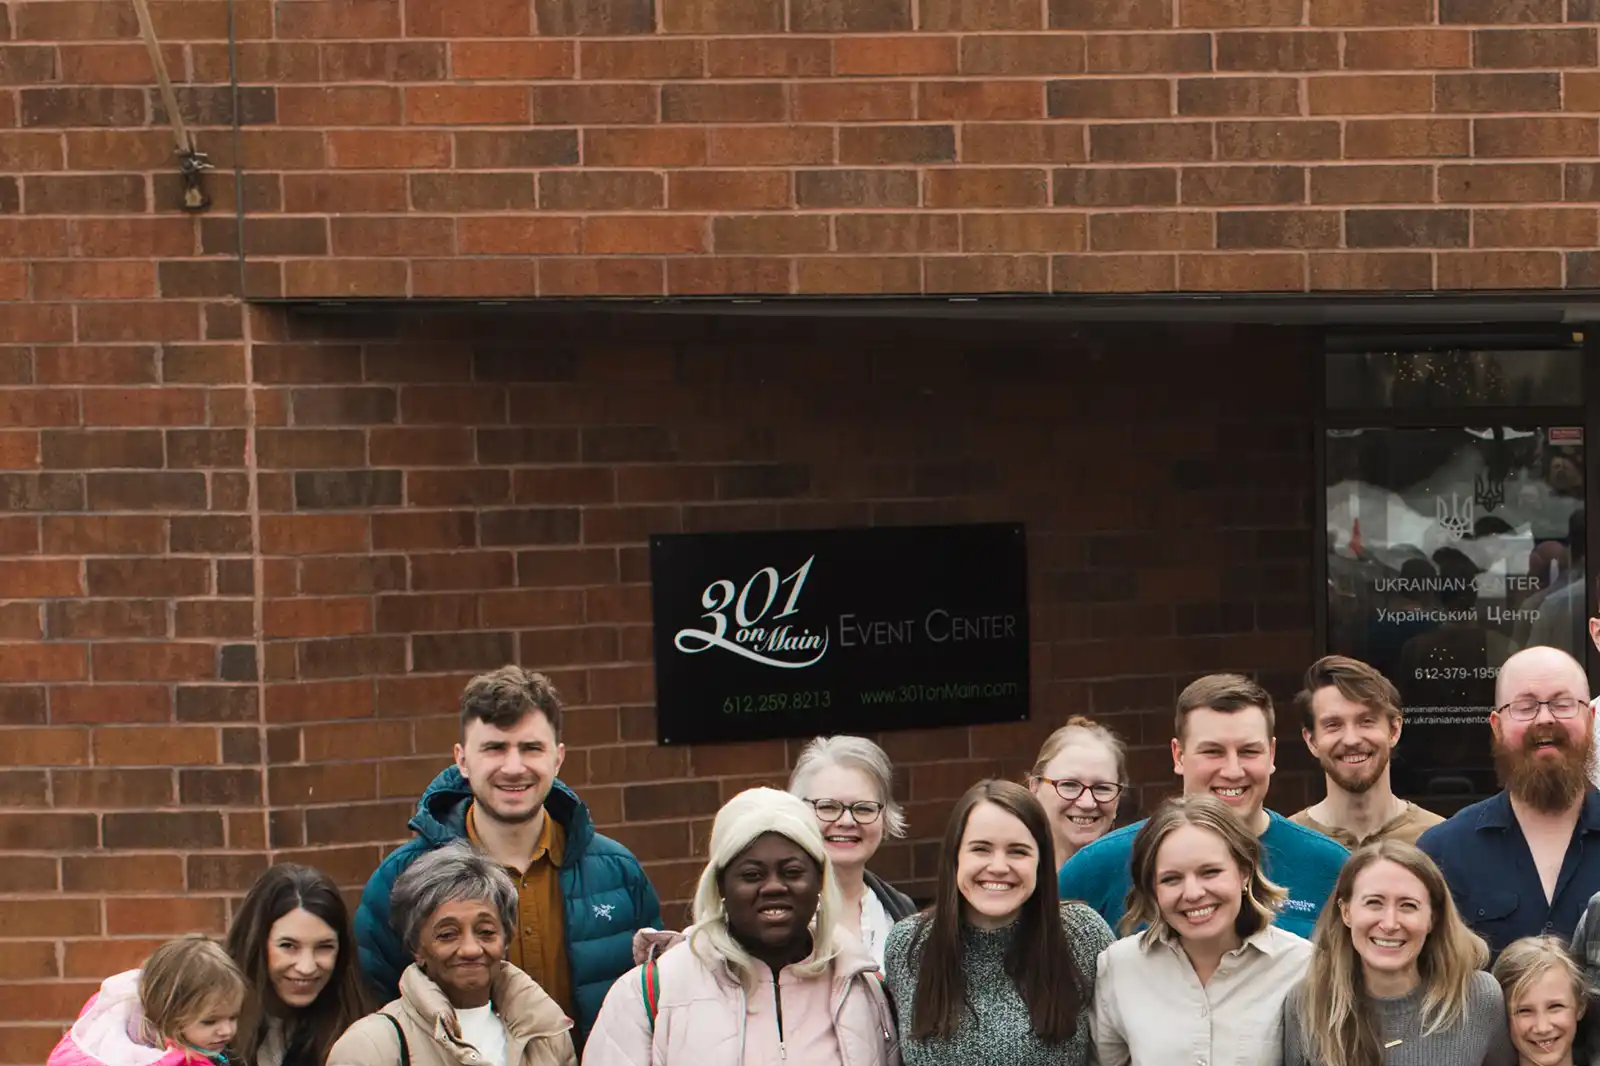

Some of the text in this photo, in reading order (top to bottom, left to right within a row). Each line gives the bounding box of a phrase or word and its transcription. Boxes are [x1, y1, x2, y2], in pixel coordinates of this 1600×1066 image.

[1374, 577, 1466, 592] UKRAINIAN
[674, 554, 816, 653] 301
[1376, 606, 1541, 625] Український Центр
[735, 625, 823, 652] on Main
[839, 608, 1016, 647] EVENT CENTER
[859, 681, 1018, 705] www.301onMain.com
